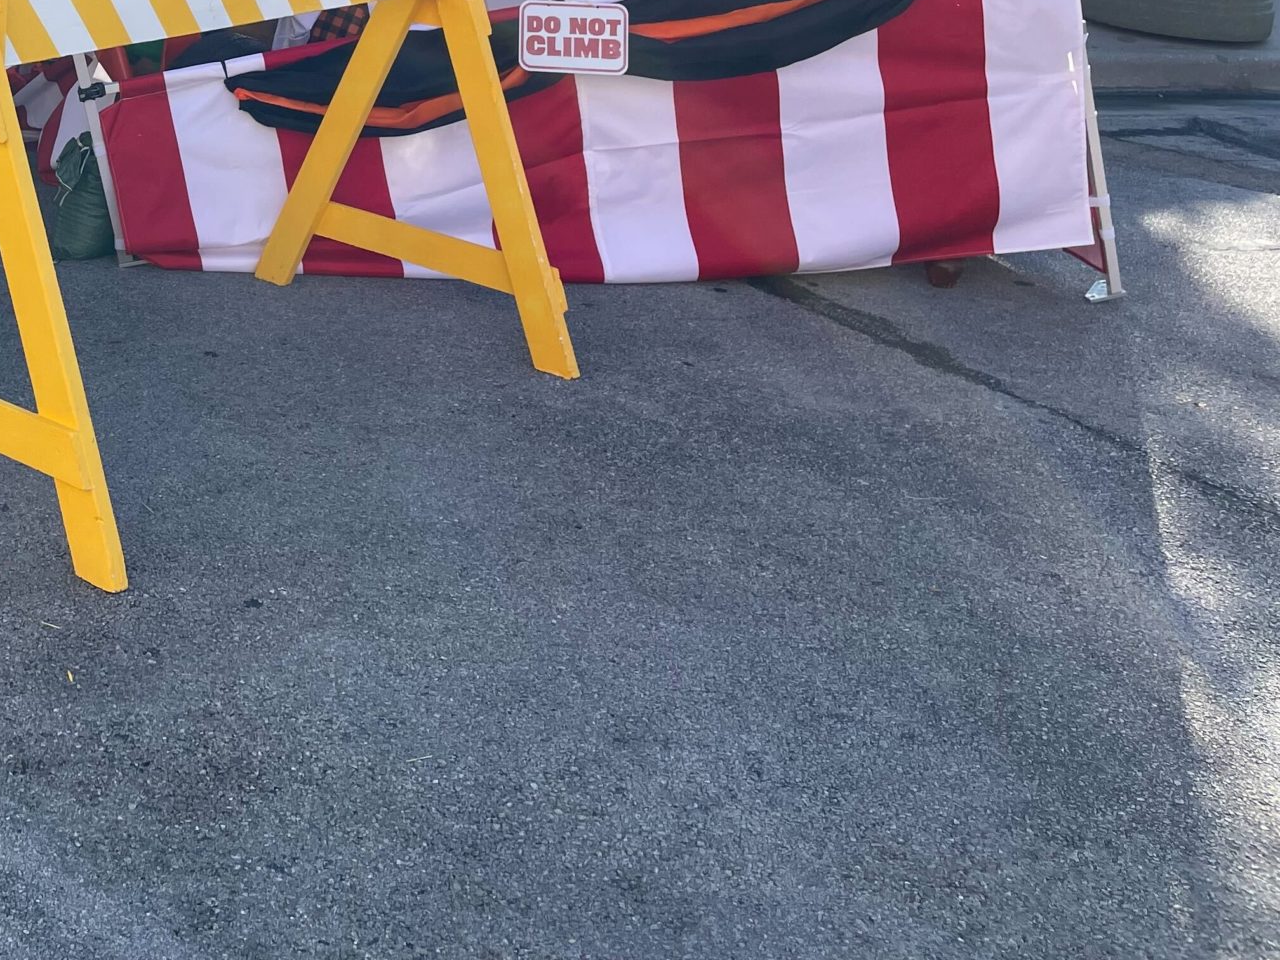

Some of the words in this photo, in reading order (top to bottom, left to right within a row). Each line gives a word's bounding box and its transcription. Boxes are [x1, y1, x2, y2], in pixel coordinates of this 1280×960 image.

[526, 15, 561, 34] DO
[568, 17, 622, 36] NOT
[525, 34, 622, 60] CLIMB
